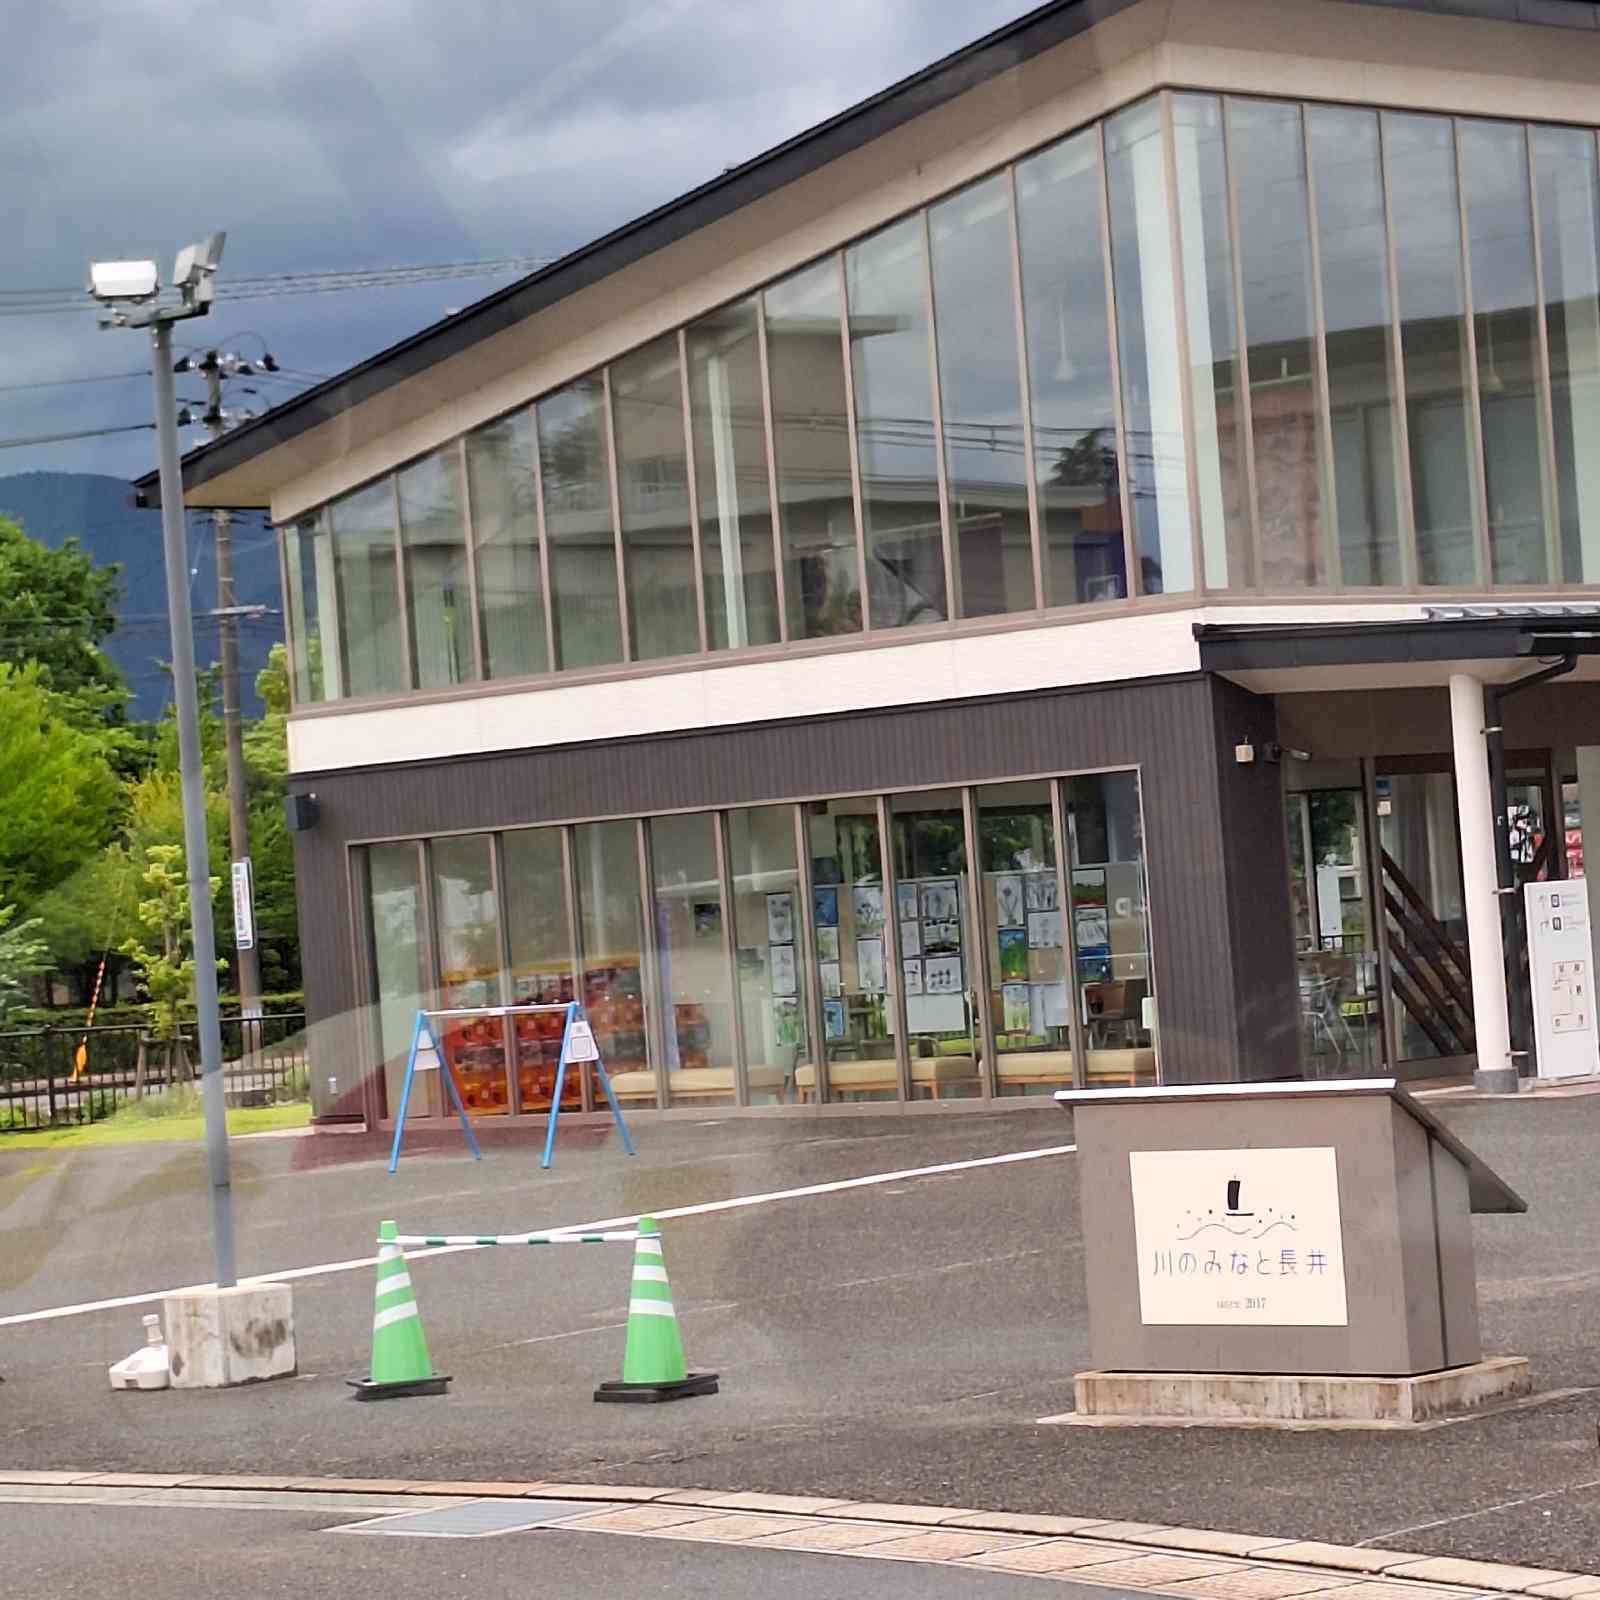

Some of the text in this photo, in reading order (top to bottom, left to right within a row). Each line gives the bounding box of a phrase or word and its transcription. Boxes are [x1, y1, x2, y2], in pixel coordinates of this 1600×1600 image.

[1153, 1249, 1328, 1276] 川のみなと長井
